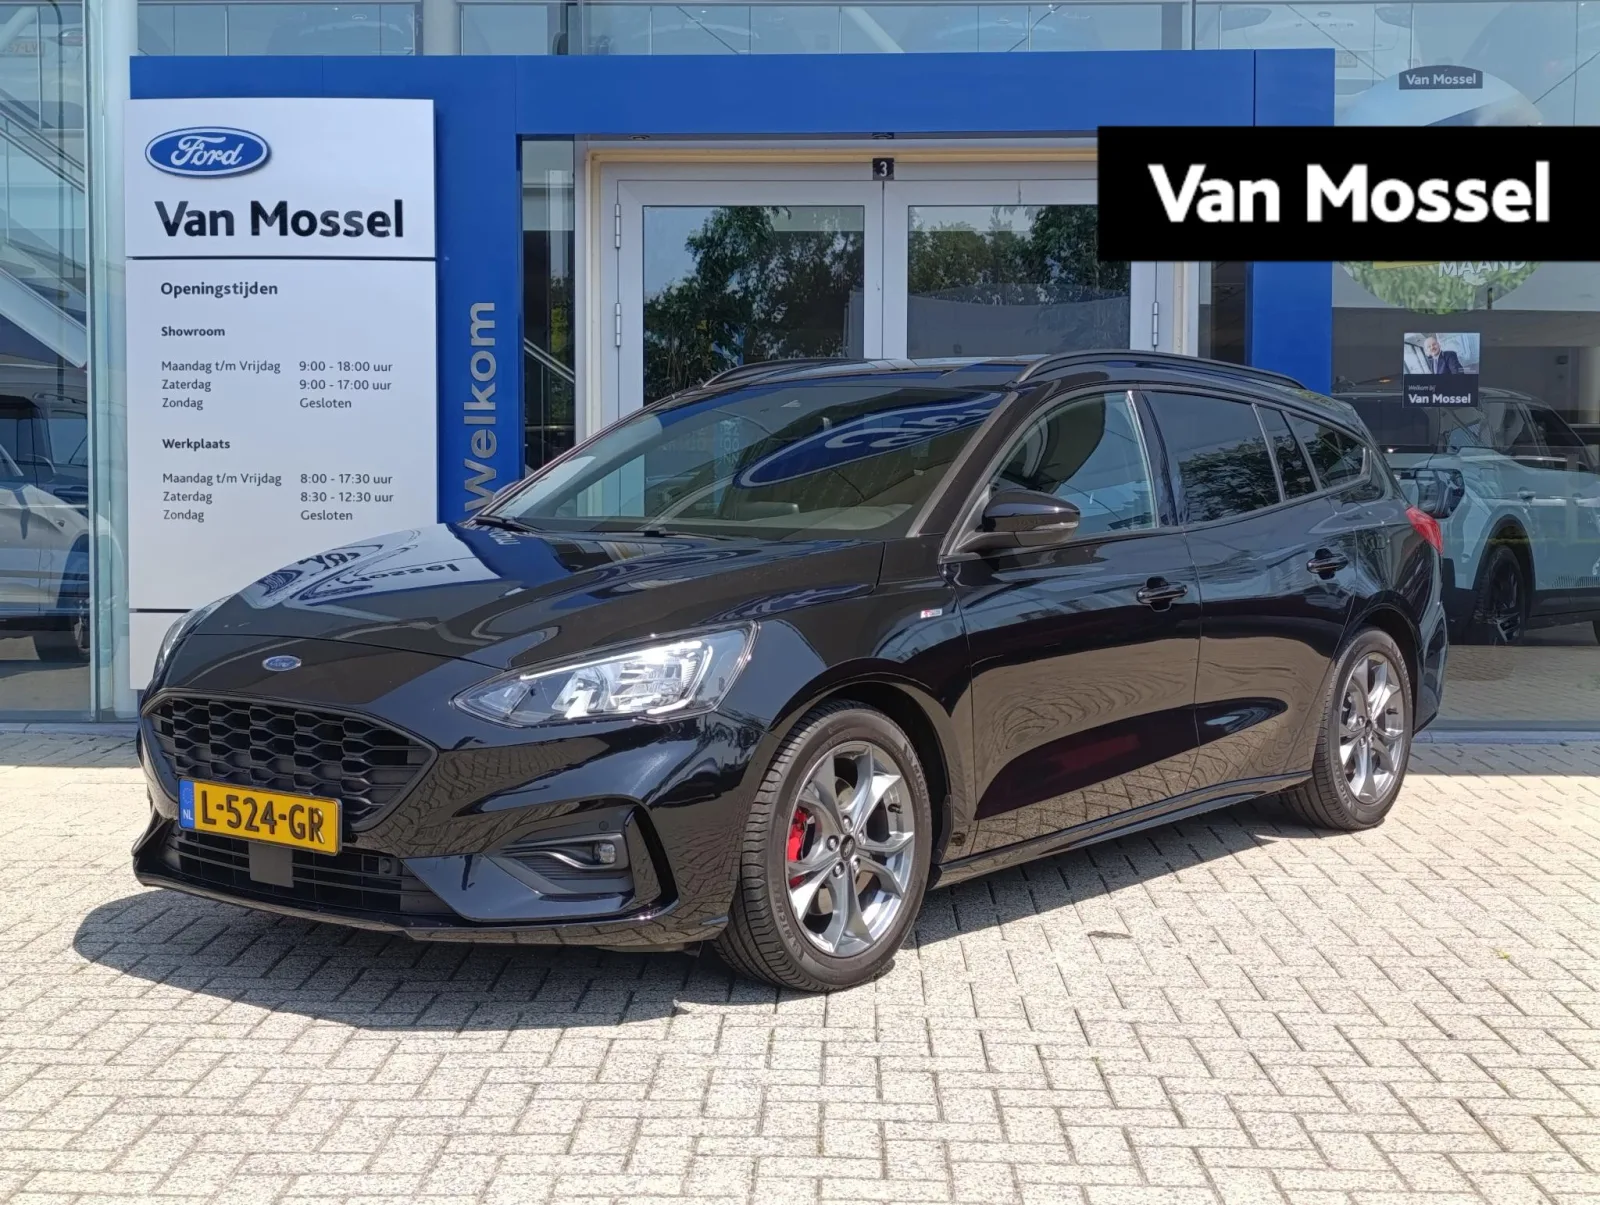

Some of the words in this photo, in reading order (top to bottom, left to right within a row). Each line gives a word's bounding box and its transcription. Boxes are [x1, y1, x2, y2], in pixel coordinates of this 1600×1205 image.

[1406, 74, 1430, 85] Van
[1433, 73, 1477, 85] Mossel
[170, 135, 244, 166] Ford
[880, 160, 888, 177] 3
[154, 200, 235, 237] Van
[250, 199, 404, 238] Mossel
[160, 281, 278, 299] Openingstijden
[161, 325, 226, 338] Showroom
[161, 359, 213, 374] Maandag
[214, 360, 237, 373] t/m
[239, 359, 281, 375] Vrijdag
[299, 360, 326, 373] 9:00
[338, 360, 370, 373] 18:00
[373, 363, 393, 373] uur
[161, 378, 212, 393] Zaterdag
[299, 379, 326, 391] 9:00
[338, 379, 370, 391] 17:00
[373, 382, 392, 391] uur
[161, 397, 204, 412] Zondag
[299, 396, 352, 409] Gesloten
[1408, 393, 1430, 404] Van
[1432, 393, 1472, 404] Mossel
[463, 302, 498, 512] Welkom
[162, 437, 231, 452] Werkplaats
[162, 472, 214, 487] Maandag
[216, 472, 238, 485] t/m
[240, 472, 282, 487] Vrijdag
[300, 473, 327, 485] 8:00
[339, 473, 371, 485] 17:30
[373, 476, 393, 485] uur
[163, 490, 213, 506] Zaterdag
[300, 491, 328, 503] 8:30
[339, 491, 371, 503] 12:30
[374, 494, 394, 503] uur
[163, 508, 205, 524] Zondag
[300, 509, 353, 522] Gesloten
[182, 808, 194, 821] NL
[201, 790, 325, 844] L-524-GR
